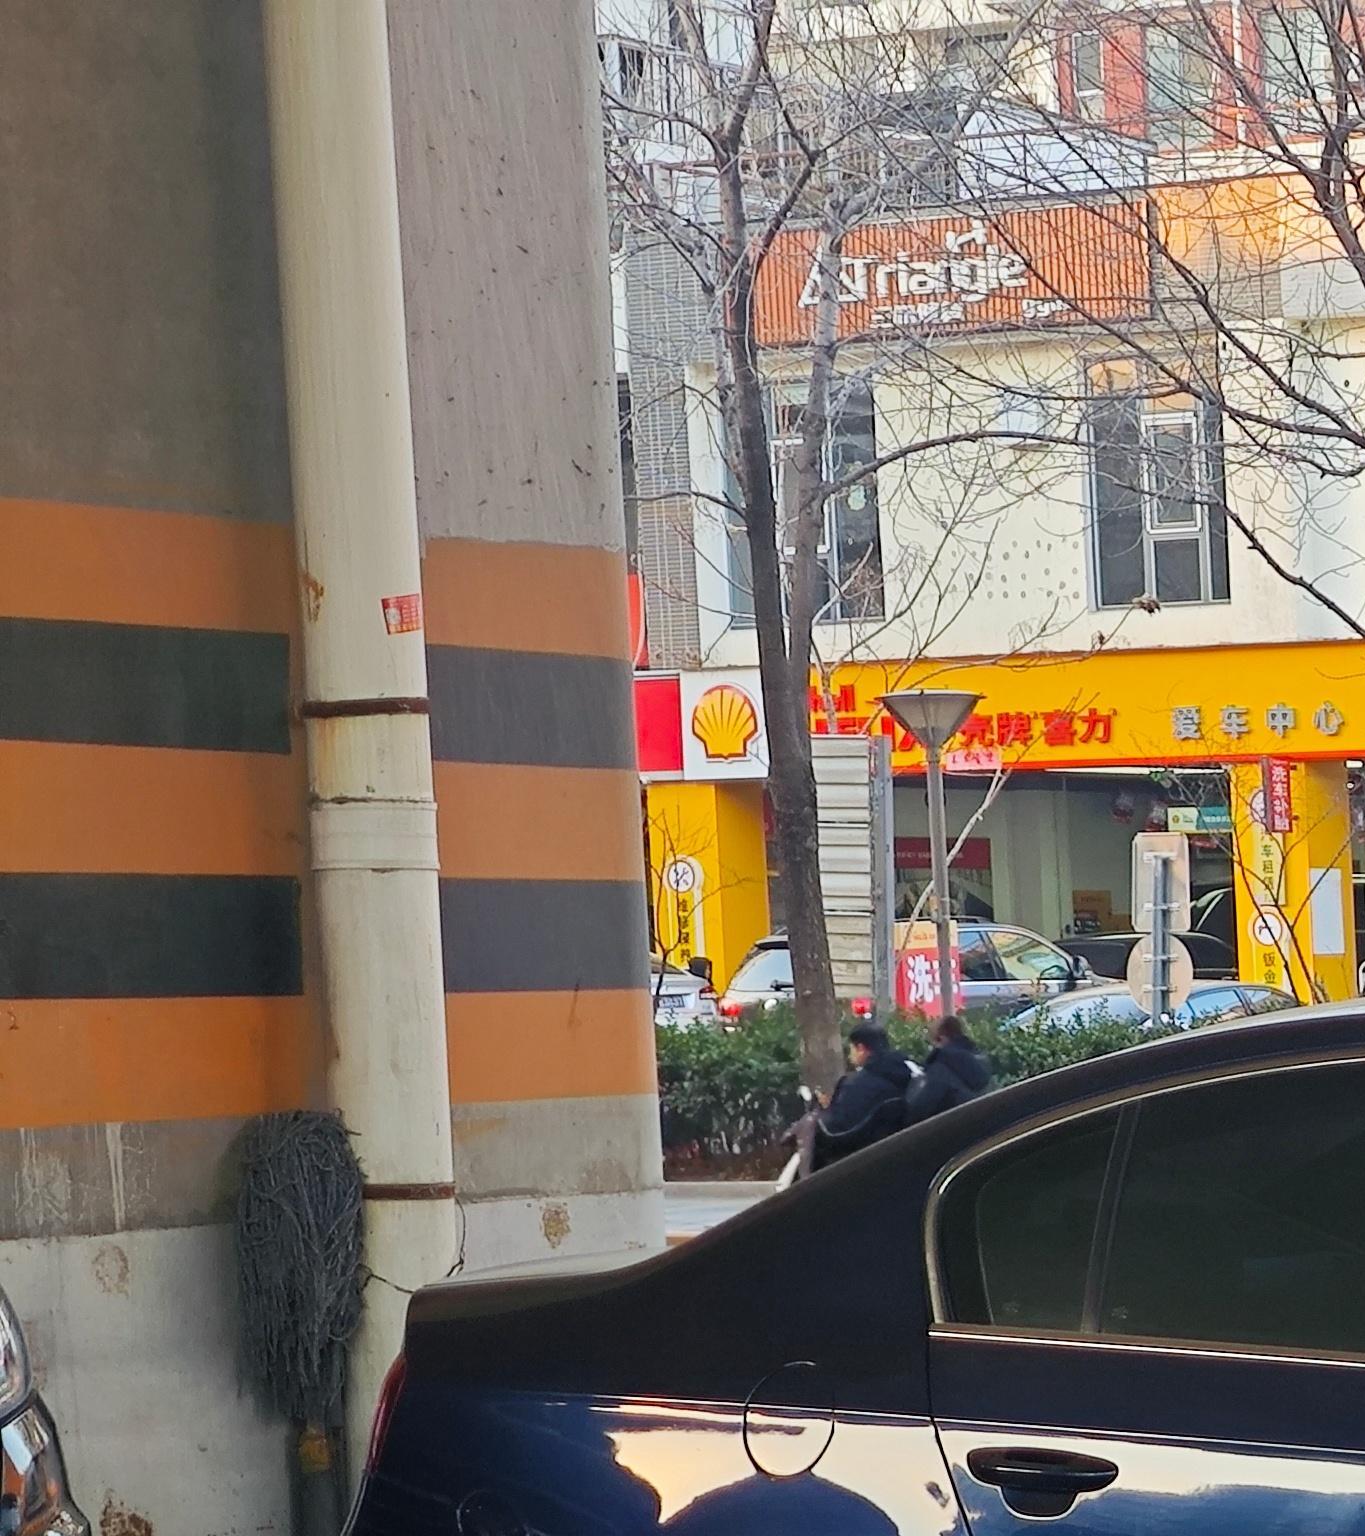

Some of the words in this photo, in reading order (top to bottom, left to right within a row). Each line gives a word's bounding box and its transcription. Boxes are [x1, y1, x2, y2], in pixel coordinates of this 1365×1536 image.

[960, 707, 1113, 749] 壳牌喜力
[1171, 700, 1345, 742] 爱车中心
